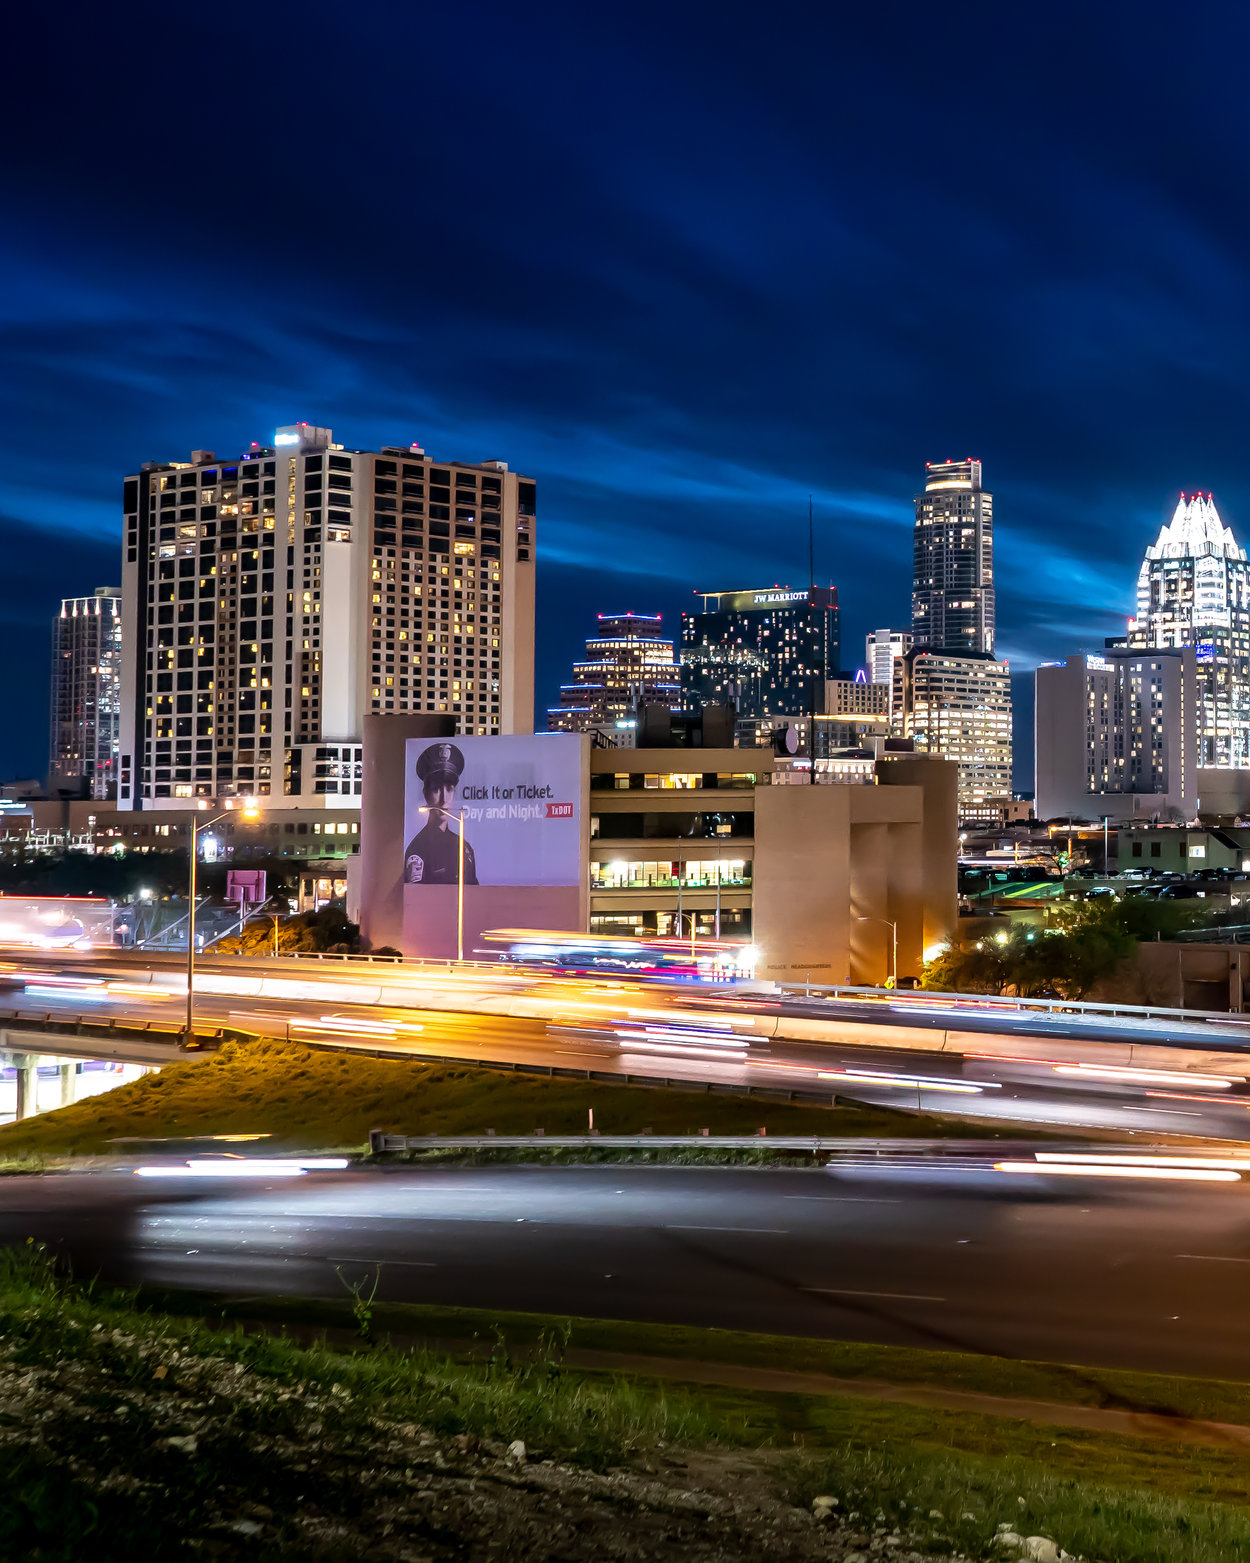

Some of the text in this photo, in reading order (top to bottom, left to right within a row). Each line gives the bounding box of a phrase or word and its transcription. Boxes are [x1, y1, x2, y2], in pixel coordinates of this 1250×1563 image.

[754, 592, 809, 603] JW MARRIOTT
[462, 784, 554, 800] Click It or Ticket.
[462, 803, 544, 822] Day and Night.
[551, 805, 571, 815] TxDOT
